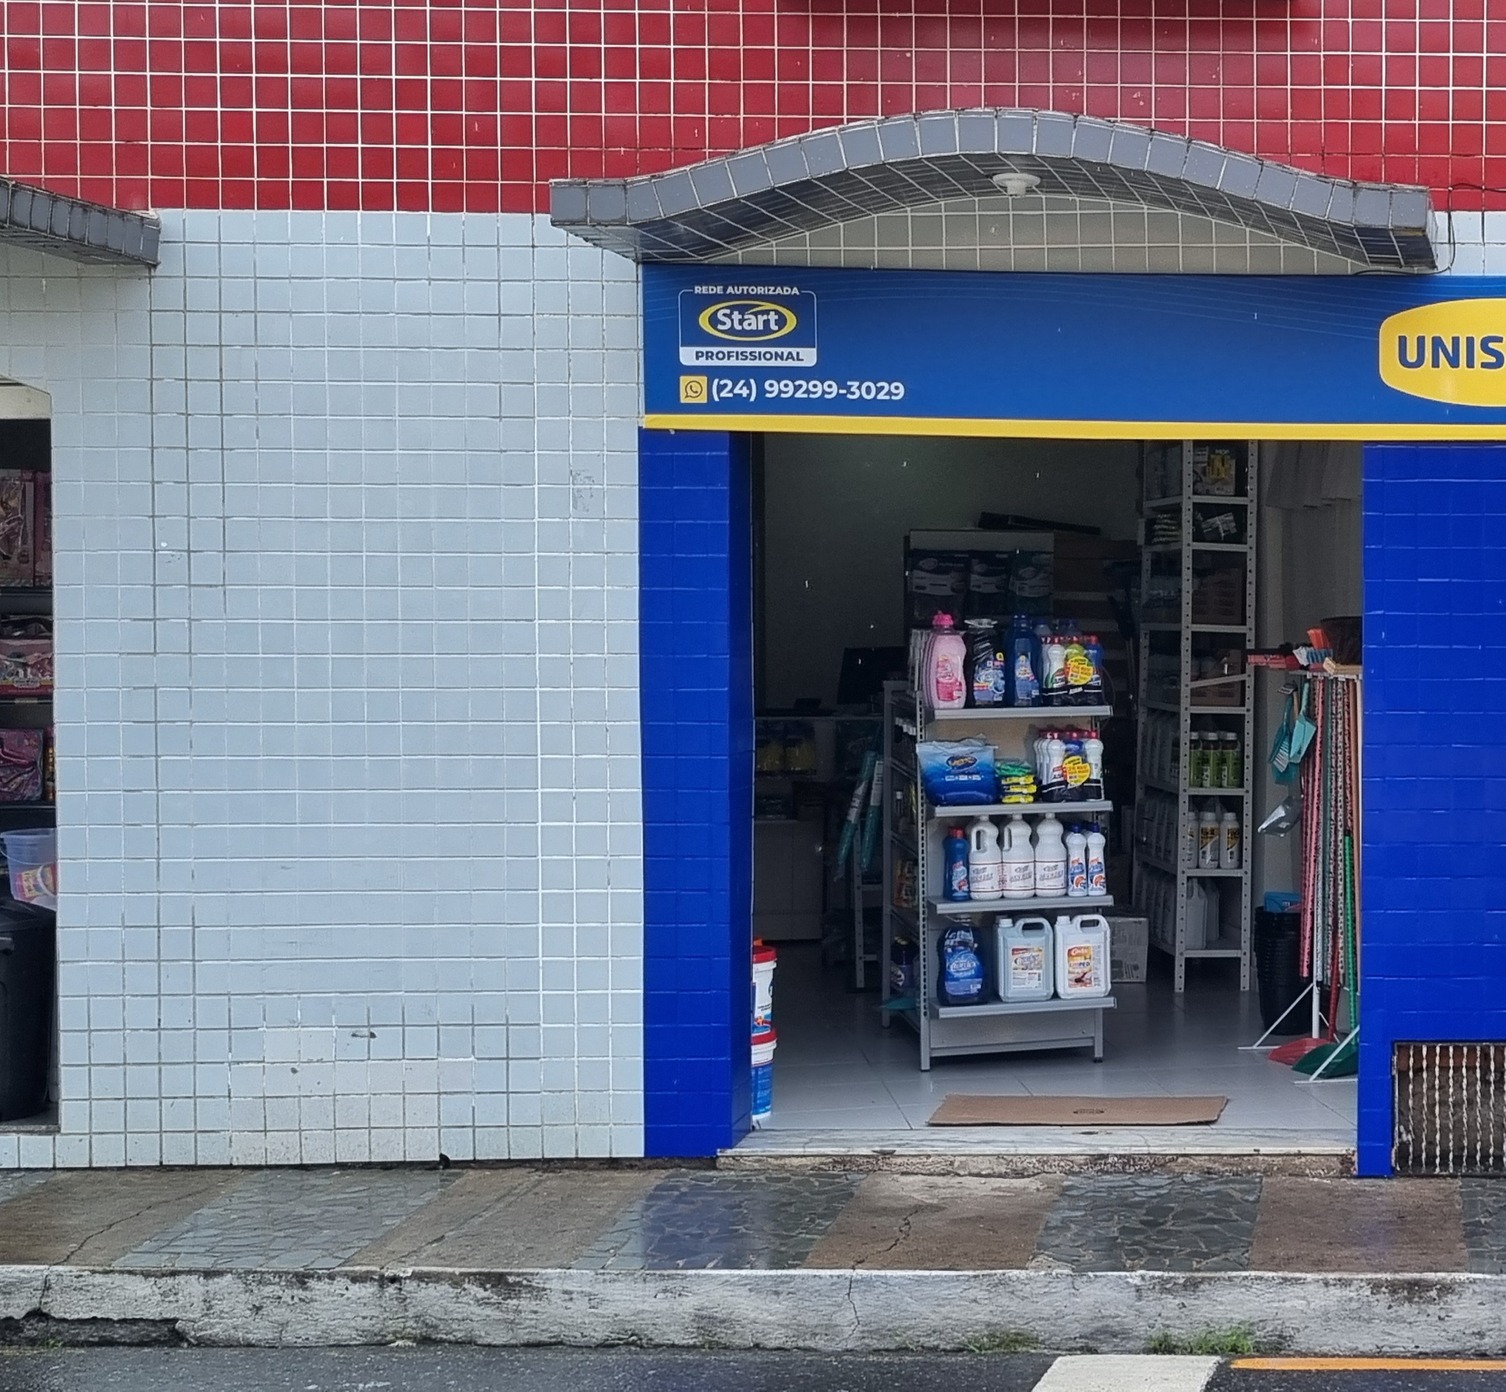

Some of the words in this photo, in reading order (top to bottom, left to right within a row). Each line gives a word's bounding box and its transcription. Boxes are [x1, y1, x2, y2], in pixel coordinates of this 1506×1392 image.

[693, 286, 724, 295] REDE
[726, 286, 800, 295] AUTORIZADA
[716, 308, 779, 331] Start
[695, 350, 804, 362] PROFISSIONAL
[712, 379, 757, 401] (24)
[764, 379, 905, 401] 99299-3029
